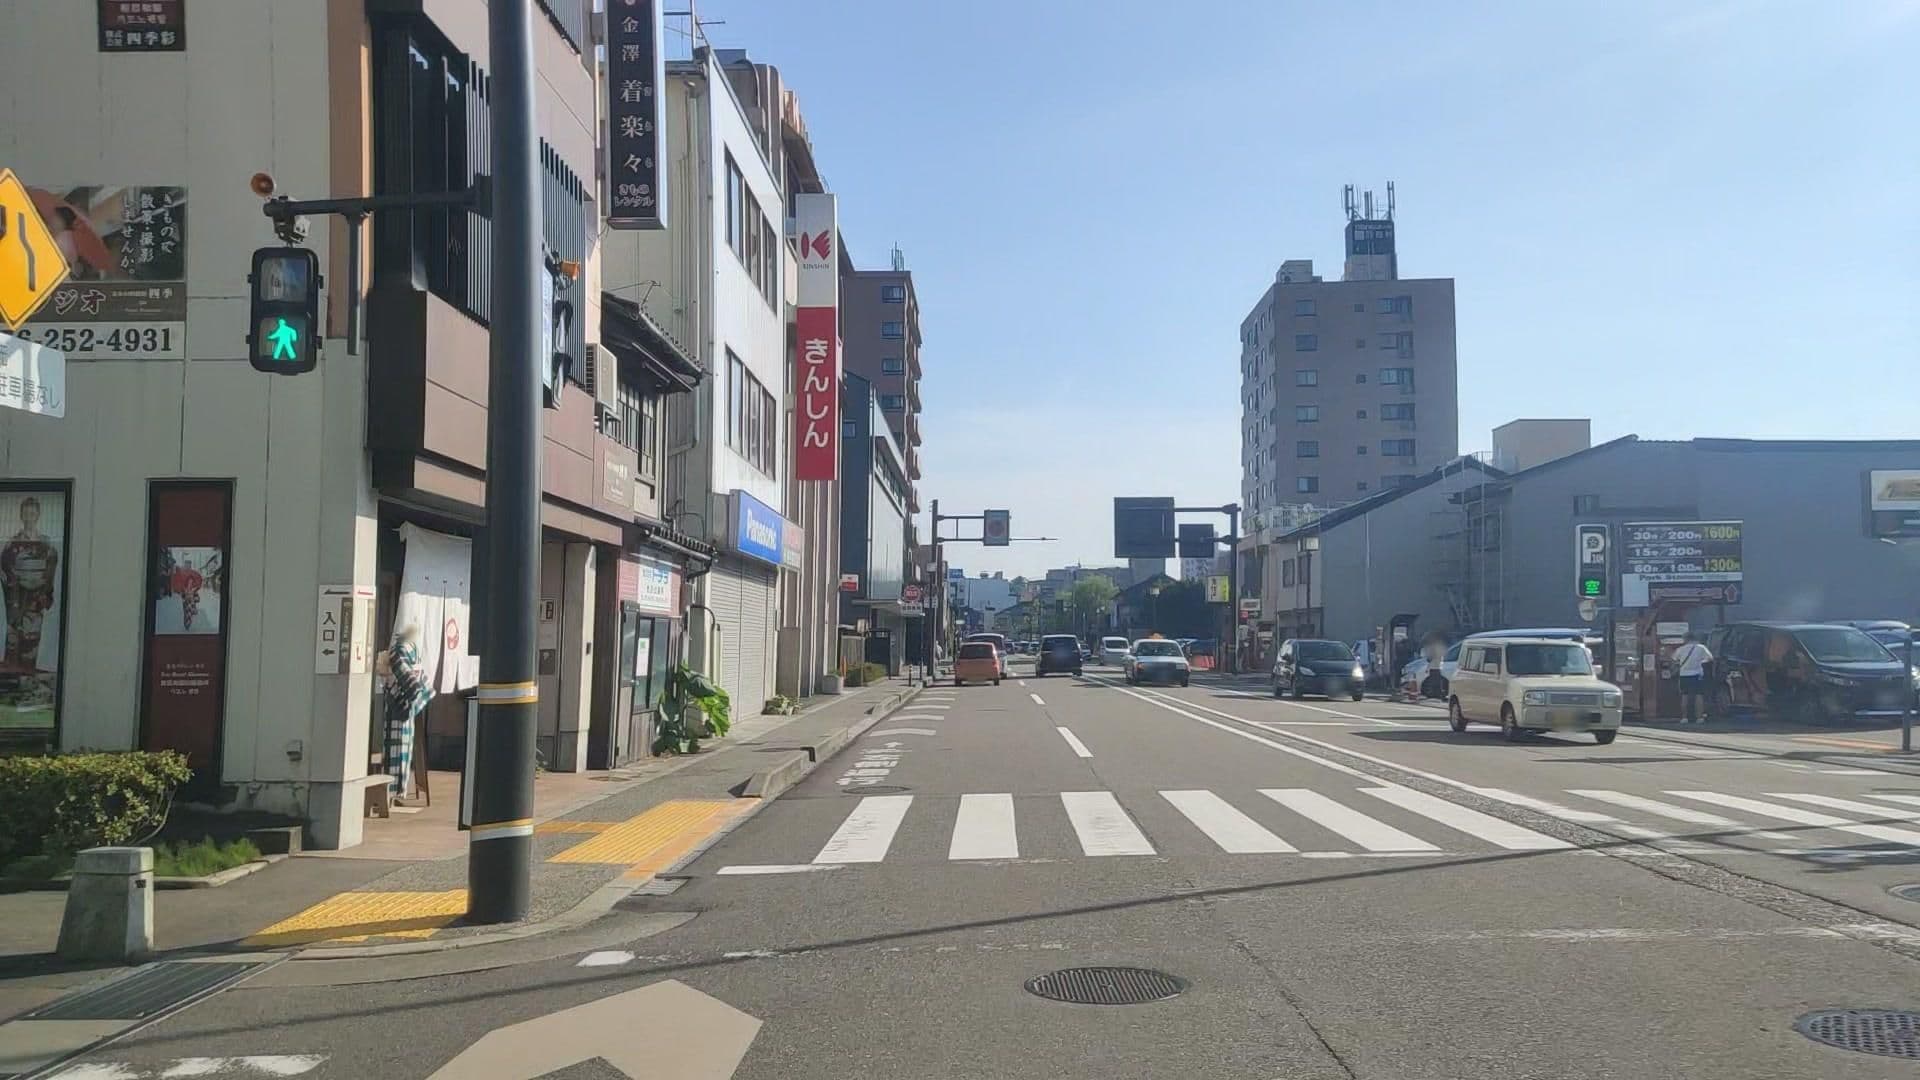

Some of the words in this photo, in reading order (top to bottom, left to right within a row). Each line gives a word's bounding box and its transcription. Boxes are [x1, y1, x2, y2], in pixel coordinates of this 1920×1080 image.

[803, 338, 830, 449] きんしん
[746, 508, 777, 551] Panasonic
[322, 611, 337, 642] 入口
